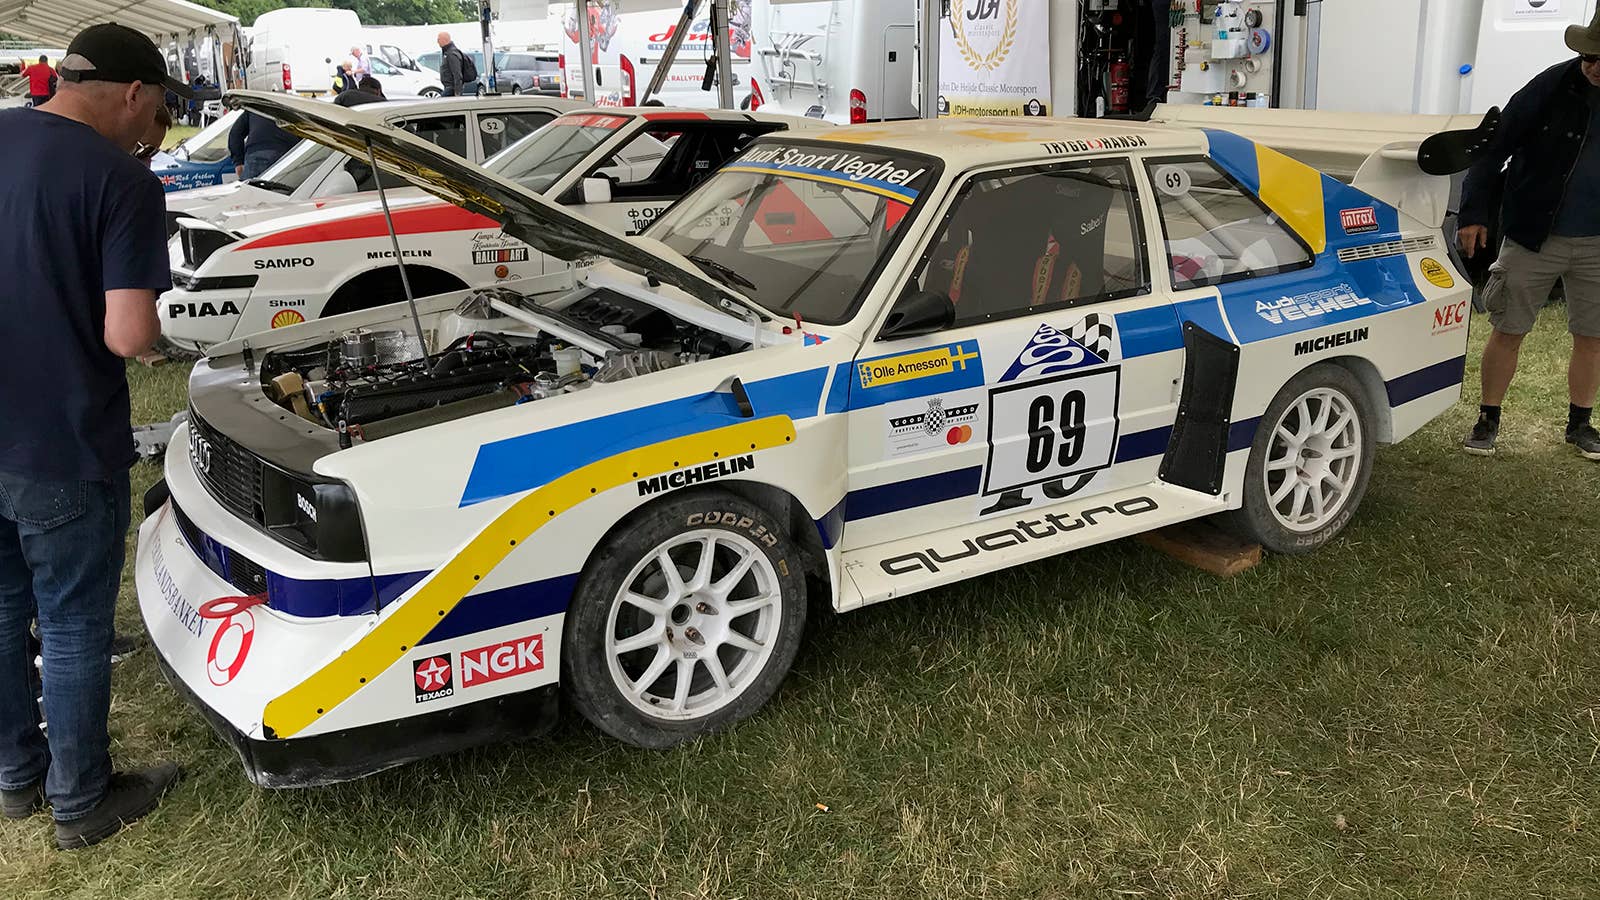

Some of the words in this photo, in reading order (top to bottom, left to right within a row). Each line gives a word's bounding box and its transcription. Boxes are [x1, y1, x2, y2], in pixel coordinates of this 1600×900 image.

[966, 0, 1000, 20] JDH
[979, 83, 998, 93] Classic
[1000, 84, 1037, 95] Motorsport
[486, 121, 498, 130] 52
[1041, 139, 1088, 154] TRYGG
[1100, 135, 1147, 149] HANSA
[735, 147, 780, 163] Audi
[775, 148, 835, 168] Sport
[832, 154, 925, 187] Veghel
[1165, 172, 1181, 188] 69
[254, 257, 315, 269] SAMPO
[169, 301, 240, 318] PIAA
[269, 299, 305, 307] Shell
[1256, 296, 1295, 312] Audi
[1432, 300, 1466, 329] NEC
[1294, 327, 1369, 356] MICHELIN
[873, 367, 895, 378] Olle
[897, 357, 948, 374] Arnesson
[1026, 389, 1086, 473] 69
[637, 454, 755, 496] MICHELIN
[297, 492, 317, 522] BOSCH
[687, 511, 778, 548] COOPER
[879, 496, 1159, 576] quattro
[463, 639, 541, 682] NGK
[416, 688, 453, 701] TEXACO
